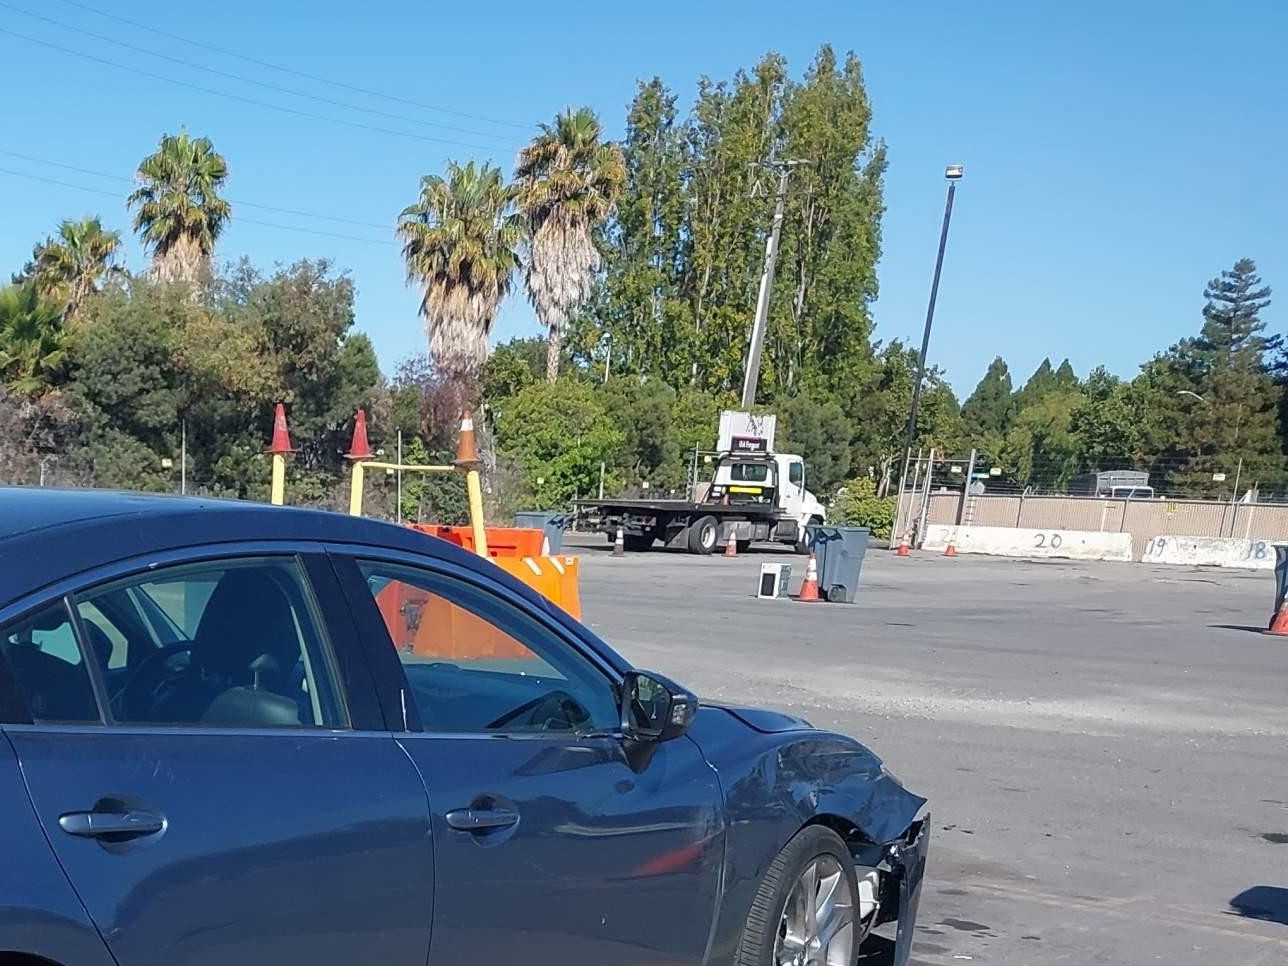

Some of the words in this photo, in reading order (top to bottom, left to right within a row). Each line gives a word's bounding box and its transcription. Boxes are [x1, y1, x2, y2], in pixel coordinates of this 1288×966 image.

[1034, 533, 1062, 549] 20
[1149, 538, 1166, 558] 19
[1246, 540, 1266, 560] 18
